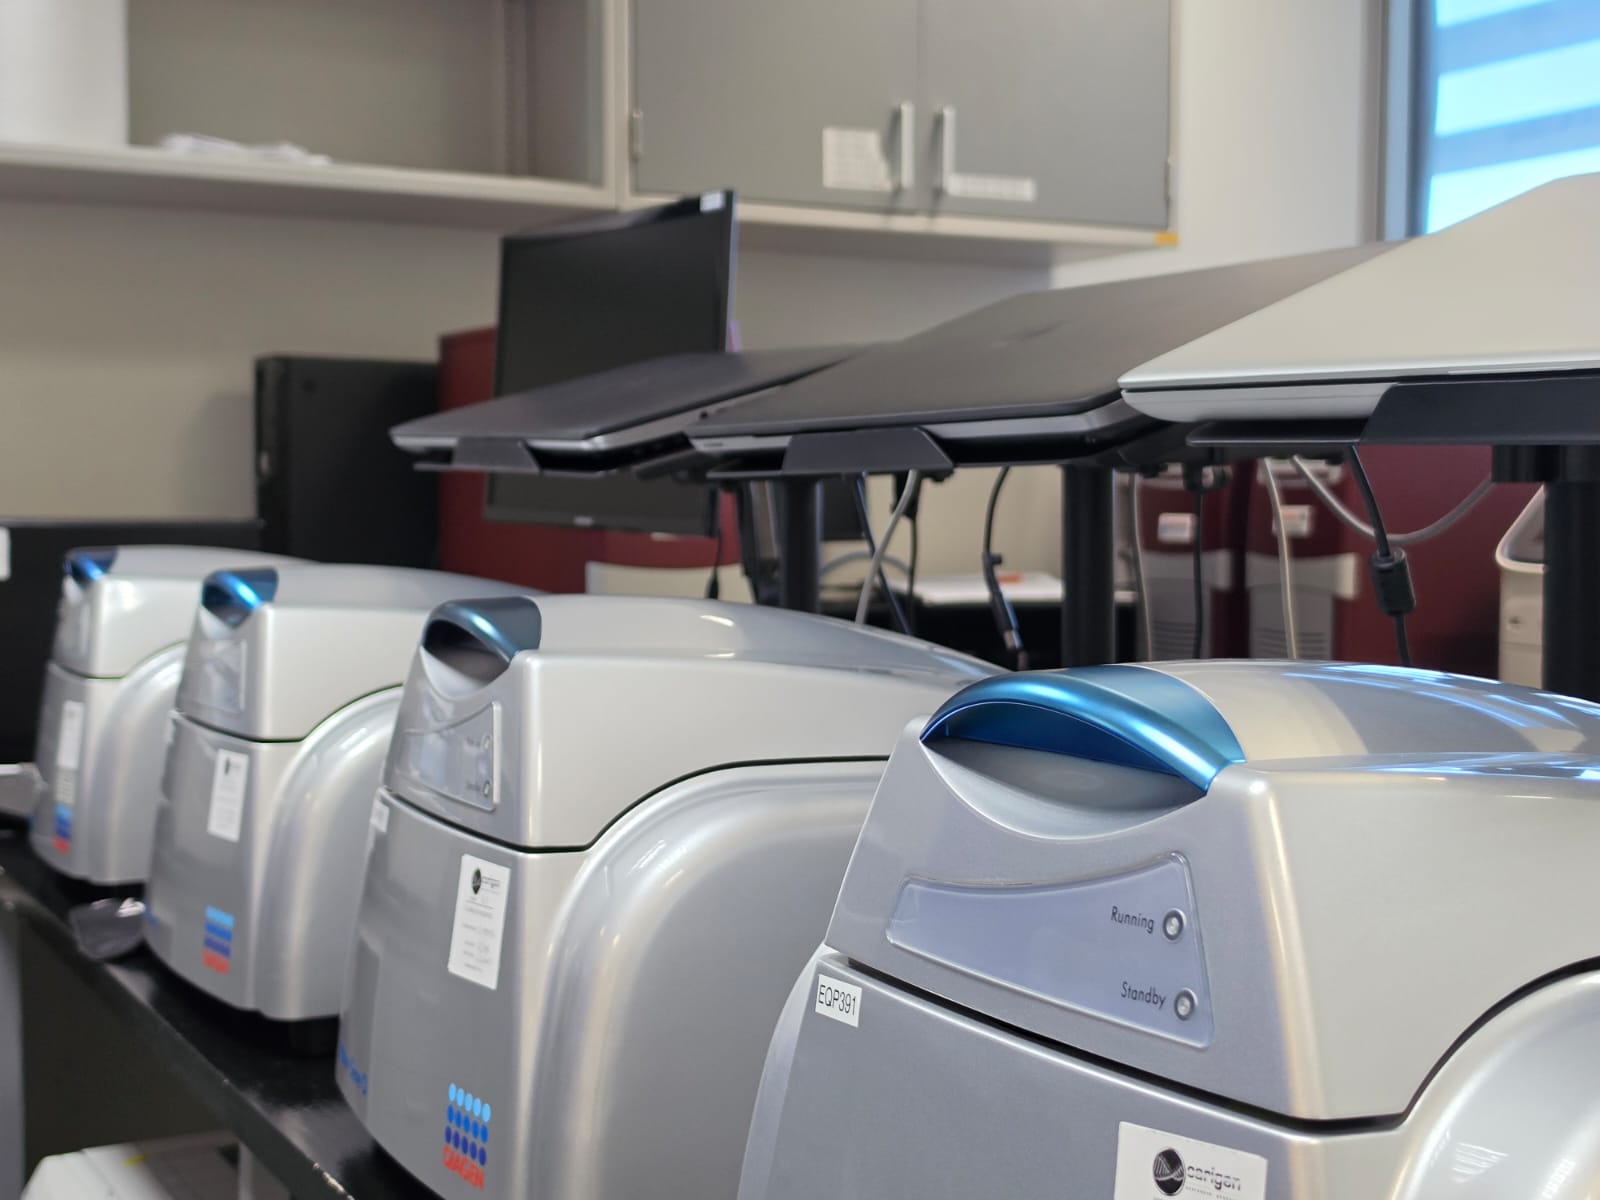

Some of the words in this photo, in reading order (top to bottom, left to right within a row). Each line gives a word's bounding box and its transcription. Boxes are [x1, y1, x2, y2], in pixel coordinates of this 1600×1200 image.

[1111, 905, 1154, 934] Running
[818, 984, 856, 1016] EQP391
[1121, 981, 1166, 1011] Standby
